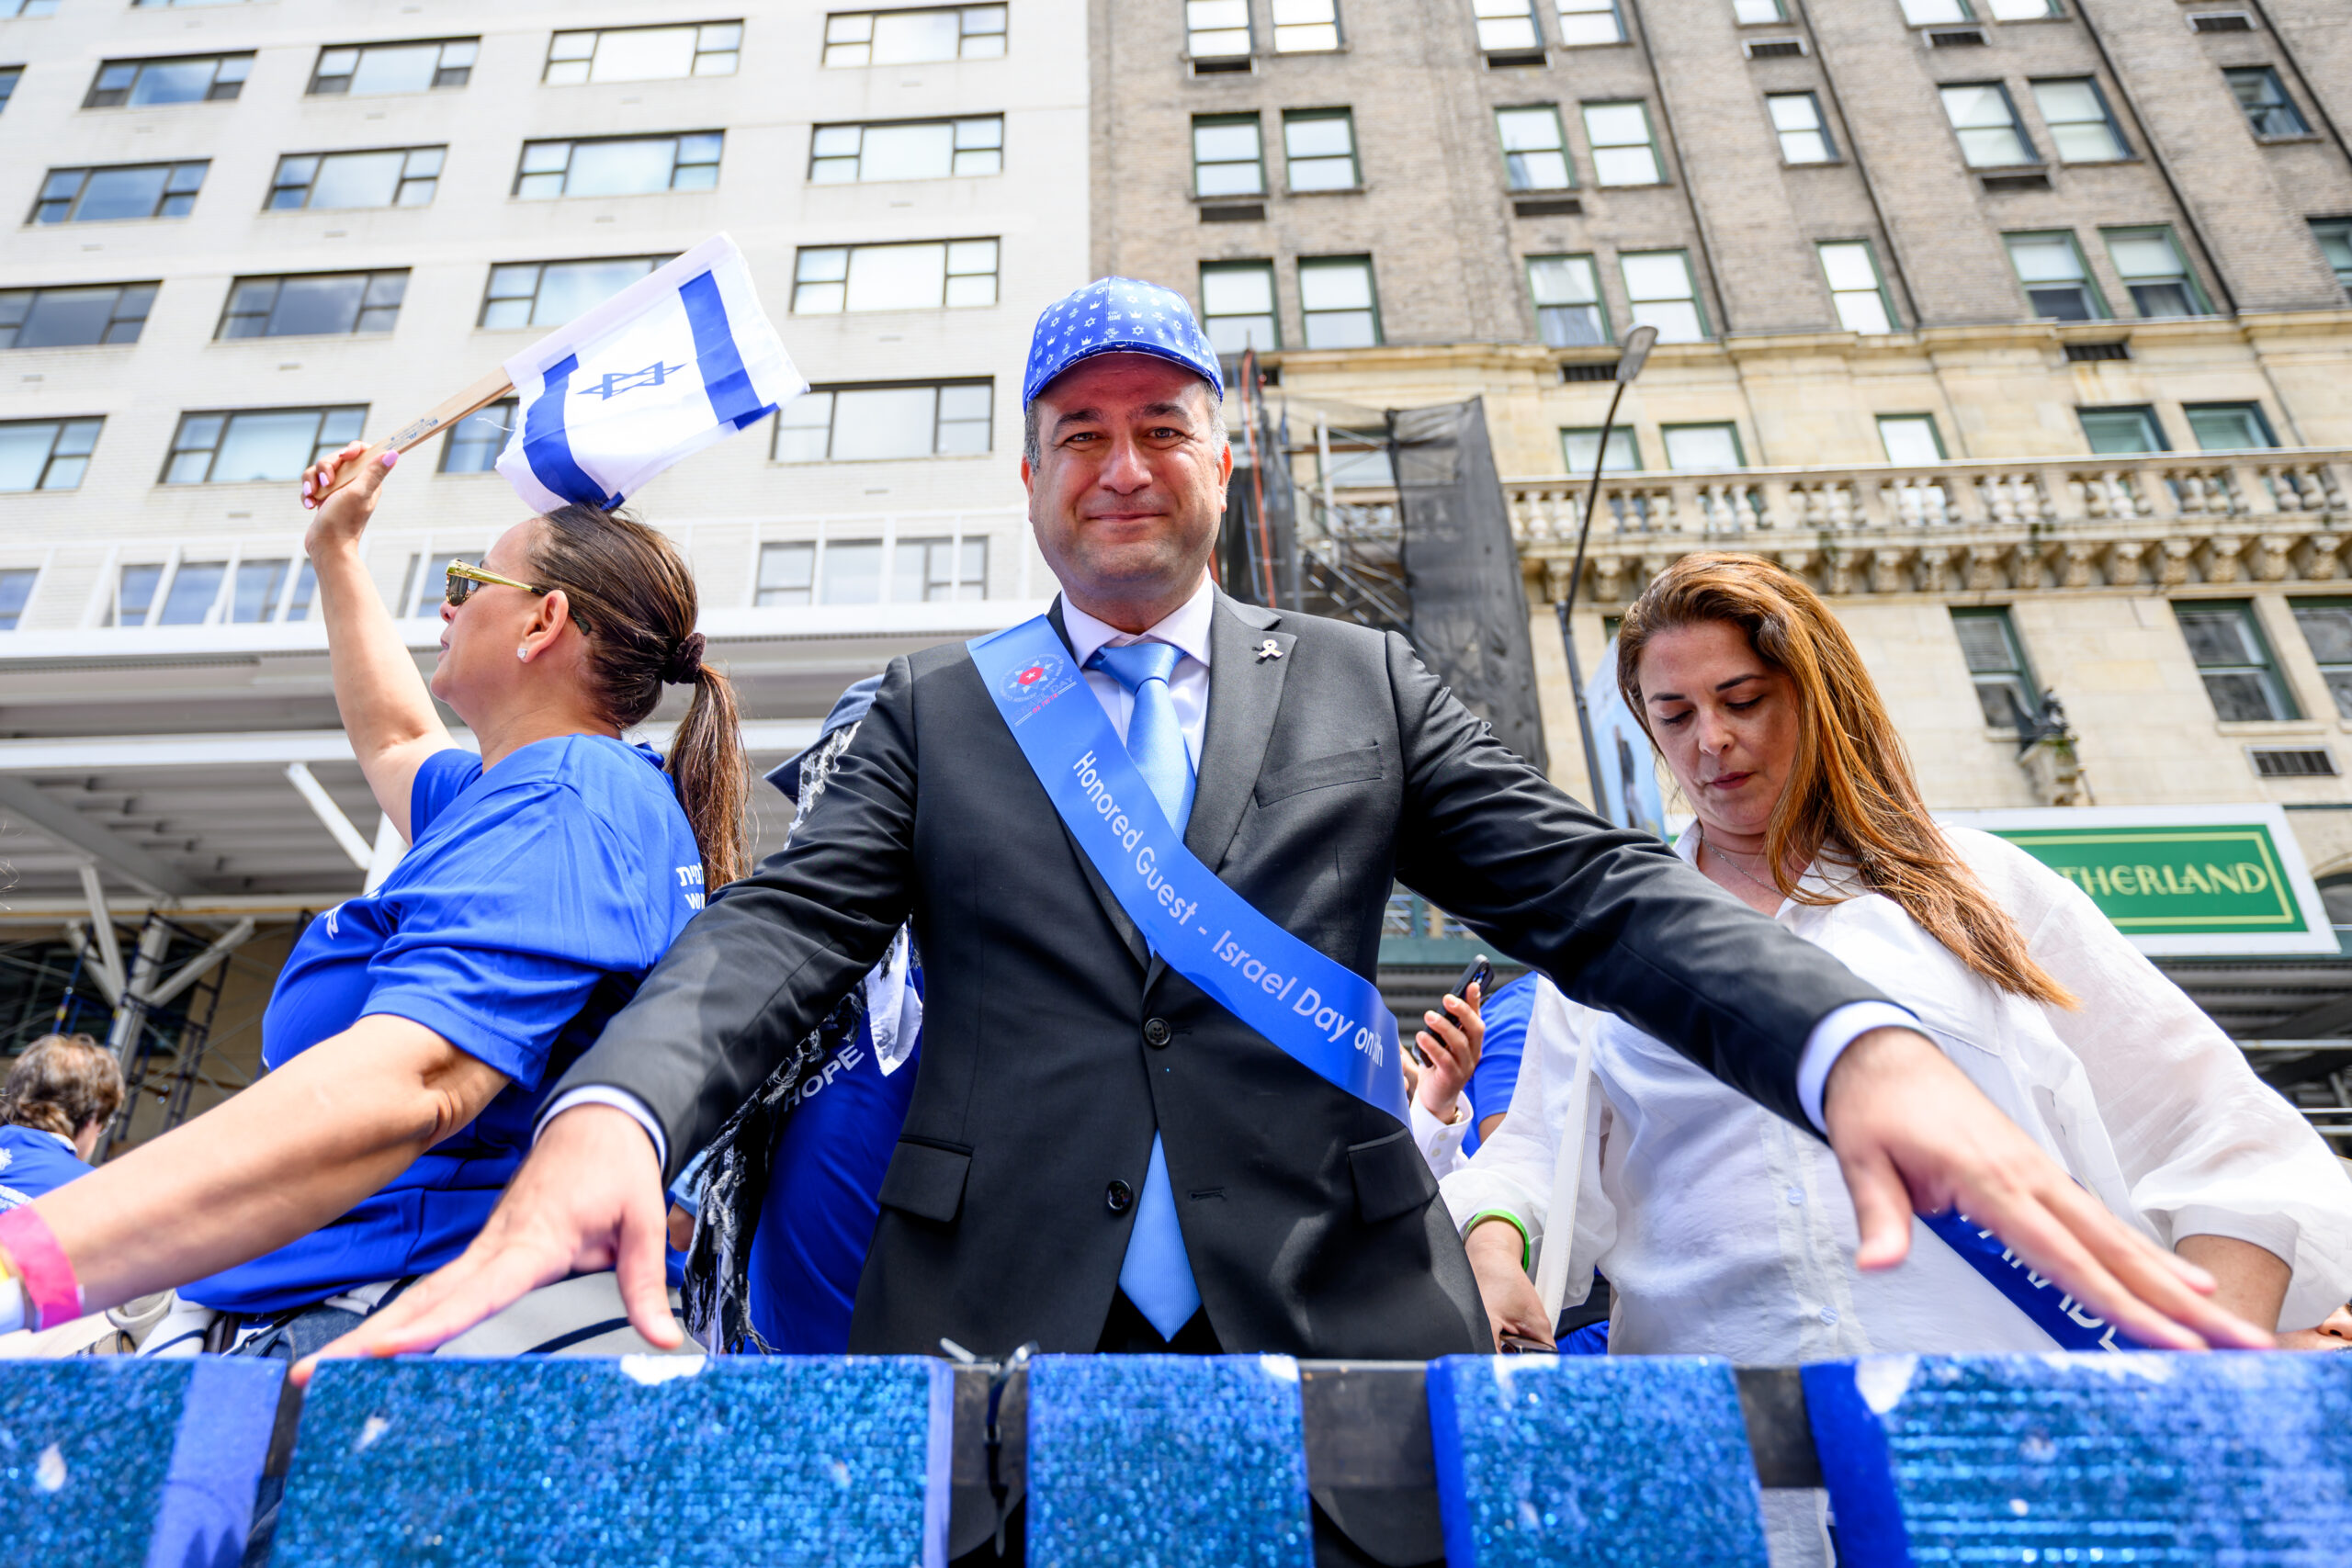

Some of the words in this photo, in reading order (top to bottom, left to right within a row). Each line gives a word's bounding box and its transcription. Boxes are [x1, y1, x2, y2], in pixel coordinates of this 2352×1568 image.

[1072, 750, 1144, 853] Honored
[1136, 846, 1198, 926] Guest
[1212, 930, 1298, 1001] Israel
[1292, 987, 1355, 1043] Day
[783, 1044, 865, 1112] HOPE
